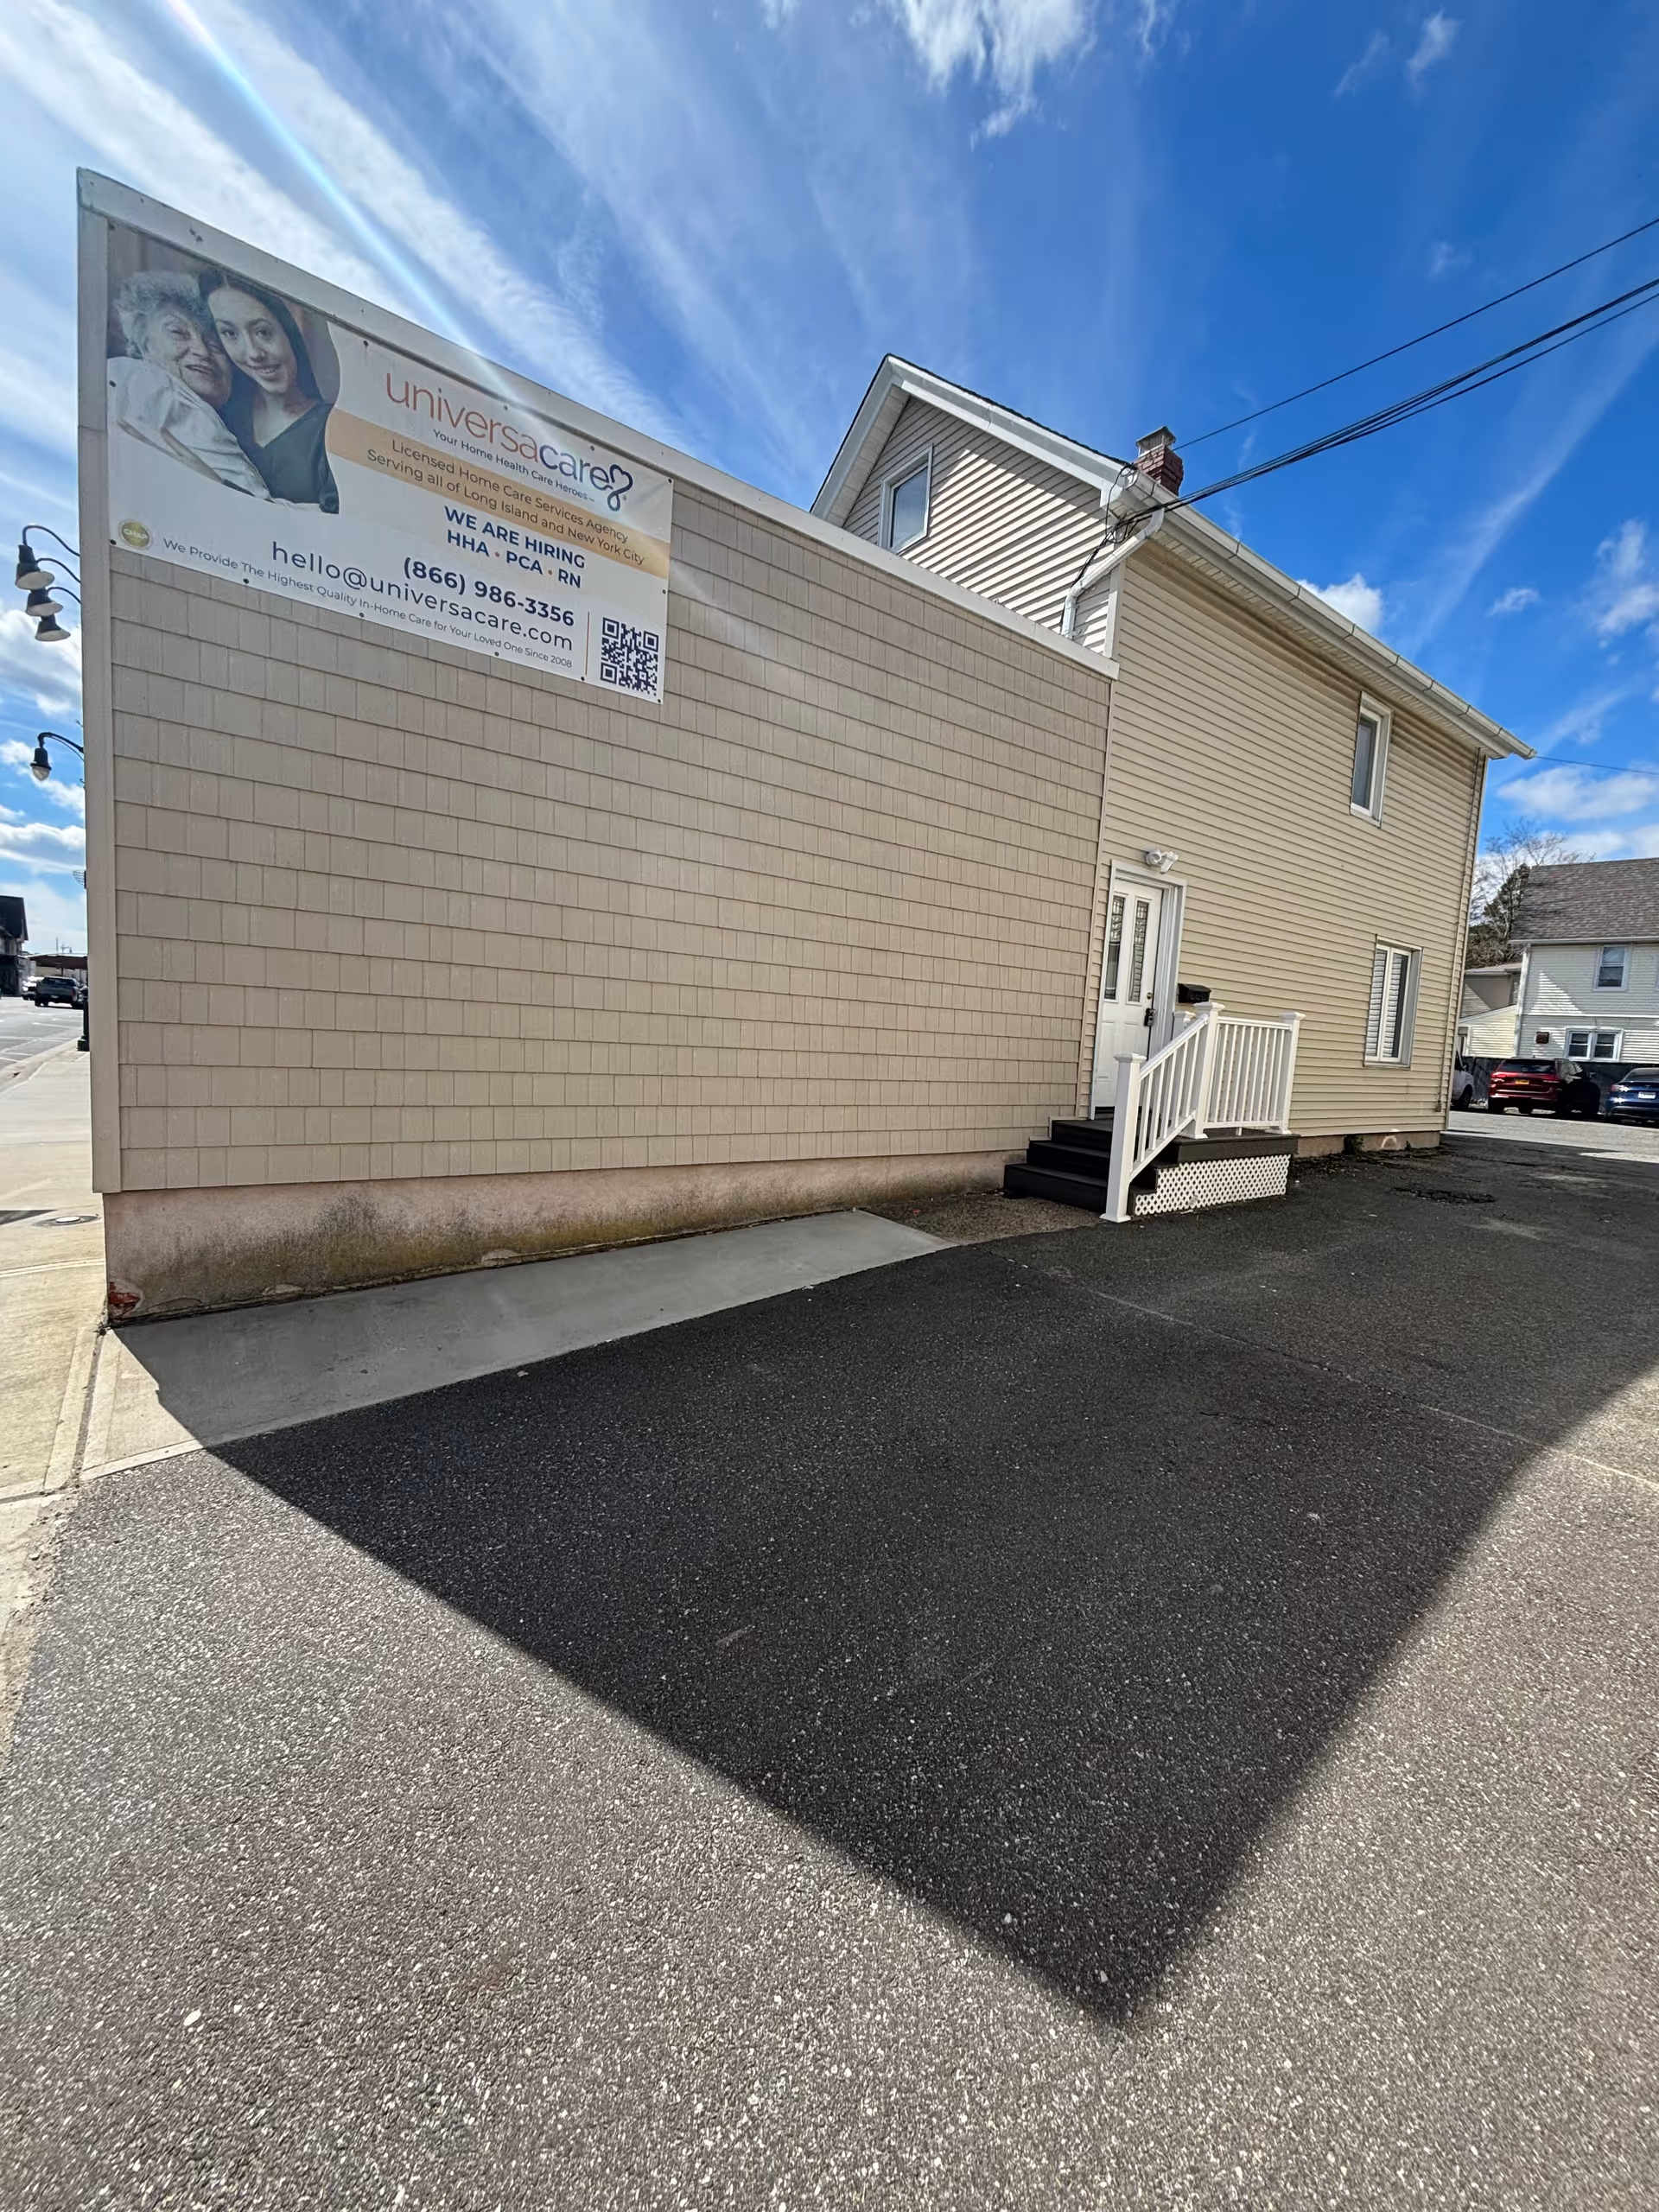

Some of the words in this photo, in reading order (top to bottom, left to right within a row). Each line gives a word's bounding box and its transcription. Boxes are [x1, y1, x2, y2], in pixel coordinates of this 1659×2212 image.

[386, 372, 613, 491] universacare
[433, 429, 458, 446] Your
[461, 440, 493, 461] Home
[496, 453, 529, 474] Health
[531, 470, 553, 486] Care
[367, 448, 423, 481] Serving
[427, 474, 443, 487] all
[447, 481, 461, 493] of
[464, 486, 497, 510] Long
[501, 500, 538, 524] Island
[541, 518, 564, 534] and
[568, 527, 594, 543] New
[597, 537, 621, 556] York
[623, 549, 645, 565] City
[392, 439, 454, 474] Licensed
[459, 467, 499, 492] Home
[503, 485, 531, 505] Care
[536, 498, 583, 525] Services
[586, 519, 628, 543] Agency
[444, 505, 477, 531] WE
[482, 522, 519, 546] ARE
[525, 536, 585, 569] HIRING
[163, 537, 186, 553] We
[189, 546, 238, 569] Provide
[241, 562, 264, 577] The
[268, 570, 314, 593] Highest
[316, 586, 357, 606] Quality
[359, 598, 406, 620] In-Home
[409, 613, 432, 627] Care
[434, 620, 448, 632] for
[449, 625, 471, 639] Your
[474, 632, 501, 648] Loved
[504, 641, 523, 654] One
[524, 648, 549, 662] Since
[550, 655, 572, 669] 2008
[273, 541, 573, 651] hello@universacare.com
[404, 557, 466, 595] (866)
[474, 581, 575, 626] 986-3356
[448, 529, 489, 557] HHA
[506, 550, 543, 575] PCA
[558, 569, 581, 588] RN
